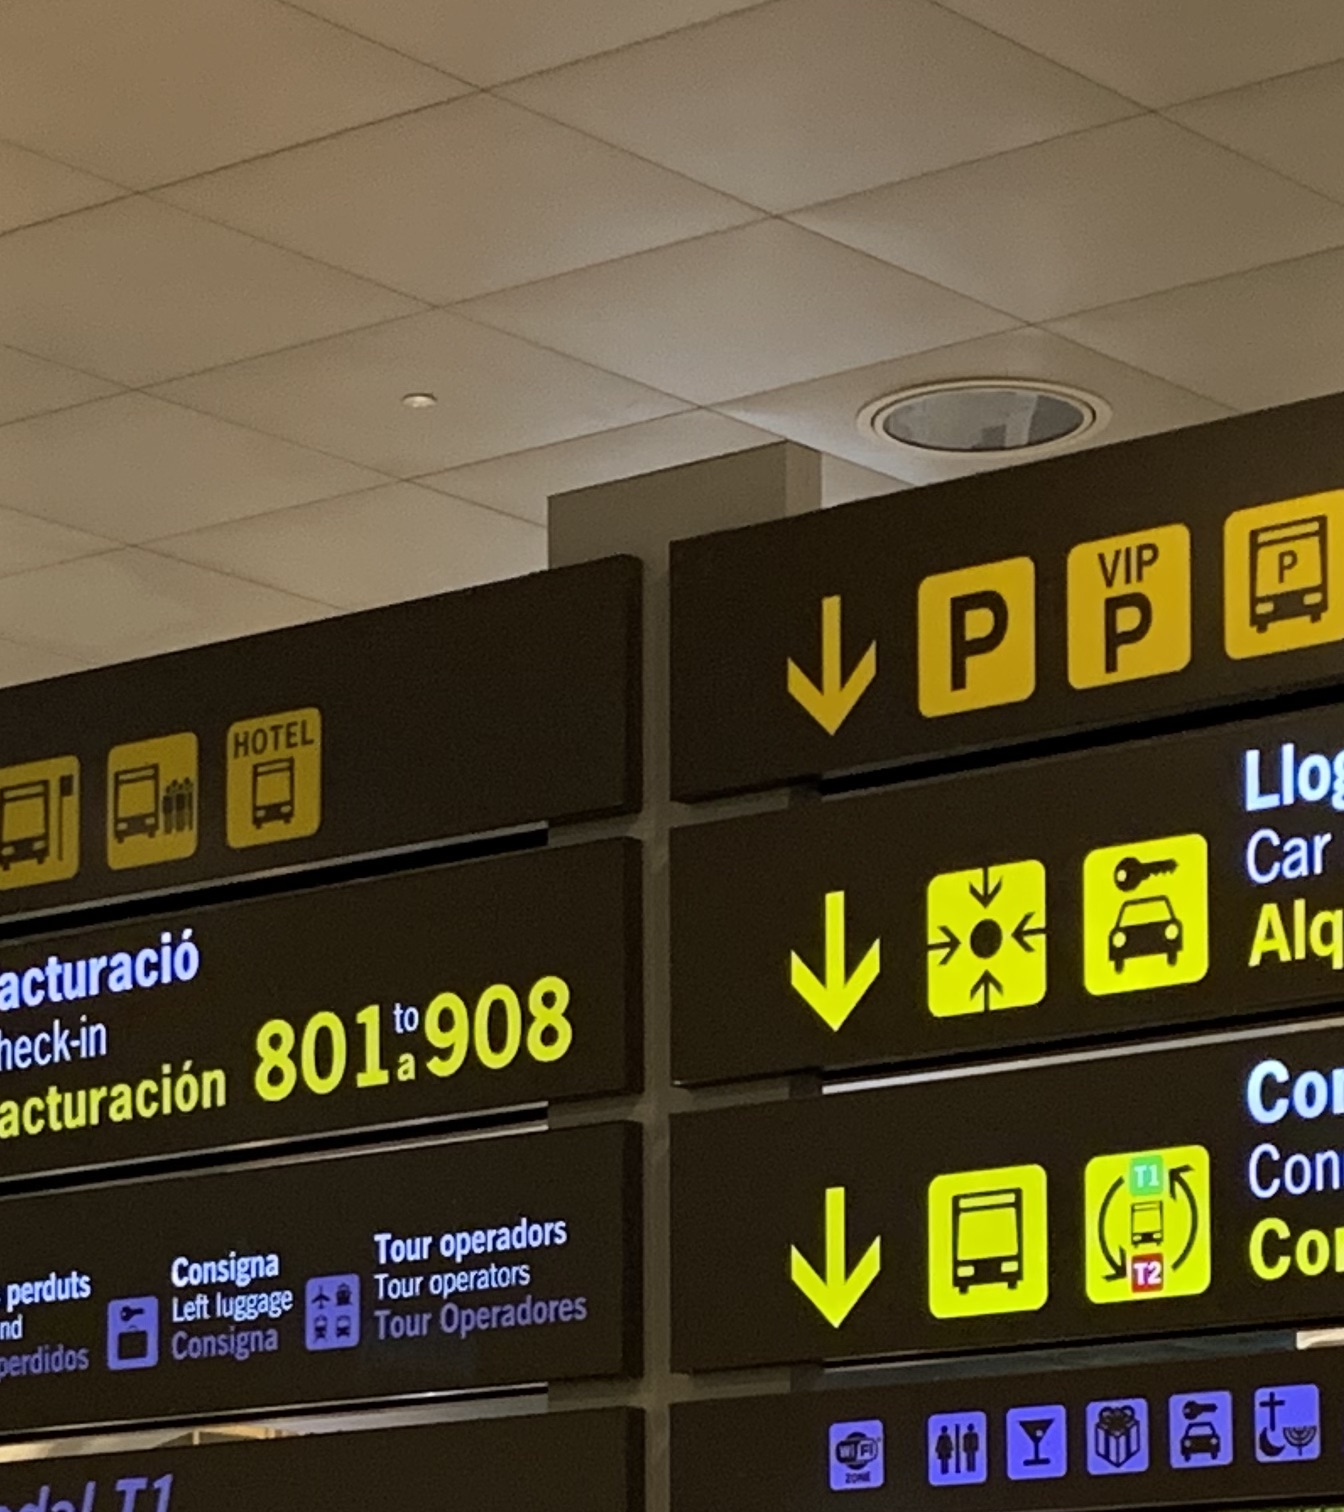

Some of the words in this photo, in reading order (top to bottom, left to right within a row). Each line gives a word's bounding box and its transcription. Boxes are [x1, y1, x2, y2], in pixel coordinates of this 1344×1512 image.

[1097, 541, 1158, 588] VIP
[1277, 549, 1299, 584] P
[950, 590, 1009, 692] P
[1104, 592, 1153, 674] P
[233, 720, 315, 759] HOTEL
[1246, 828, 1332, 884] Car
[393, 1002, 419, 1034] to
[424, 975, 573, 1077] 908
[254, 1004, 389, 1102] 801
[397, 1051, 416, 1082] a
[1133, 1163, 1160, 1189] T1
[373, 1232, 433, 1265] Tour
[439, 1217, 567, 1263] operadors
[171, 1251, 280, 1289] Consigna
[373, 1273, 424, 1300] Tour
[429, 1263, 531, 1298] operators
[1133, 1260, 1162, 1287] T2
[6, 1270, 91, 1313] perduts
[172, 1295, 211, 1323] Left
[216, 1289, 293, 1323] luggage
[373, 1309, 432, 1340] Tour
[440, 1293, 587, 1338] Operadores
[171, 1325, 278, 1361] Consigna
[844, 1470, 871, 1484] ZONE
